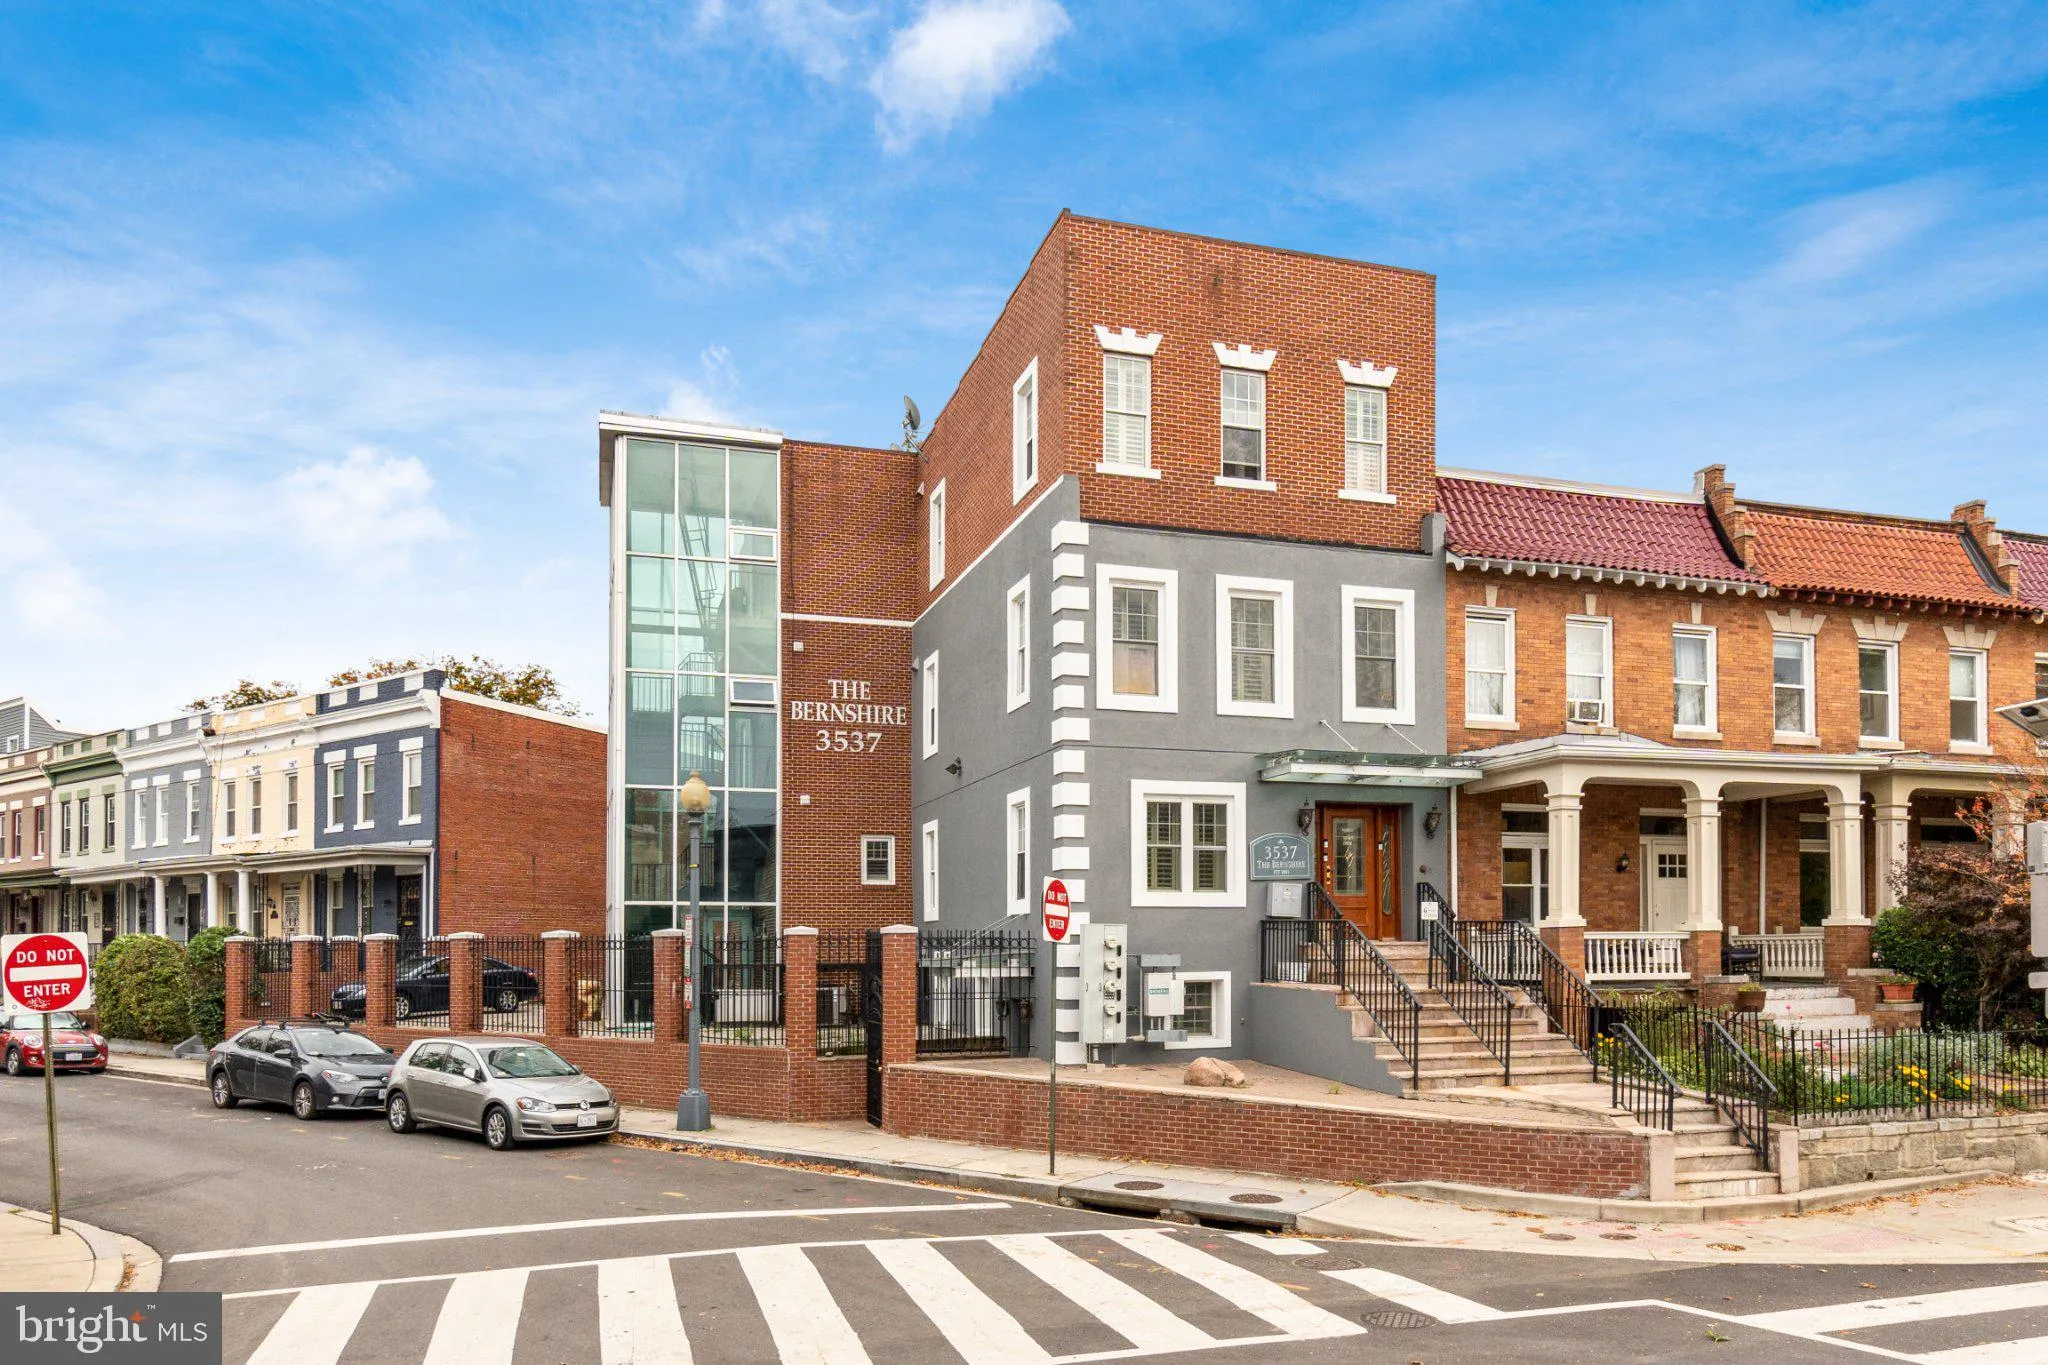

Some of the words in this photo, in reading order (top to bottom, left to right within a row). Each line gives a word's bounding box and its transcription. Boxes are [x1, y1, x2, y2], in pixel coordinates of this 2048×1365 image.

[828, 680, 871, 700] THE
[790, 700, 907, 726] BERNSHIRE
[815, 730, 882, 753] 3537
[1264, 845, 1298, 859] 3537
[1257, 860, 1271, 869] THE
[1272, 860, 1306, 869] BERNSHIRE
[1047, 889, 1055, 901] DO
[1057, 891, 1067, 903] NOT
[1049, 918, 1065, 930] ENTER
[16, 950, 37, 964] DO
[46, 948, 75, 963] NOT
[23, 982, 71, 998] ENTER
